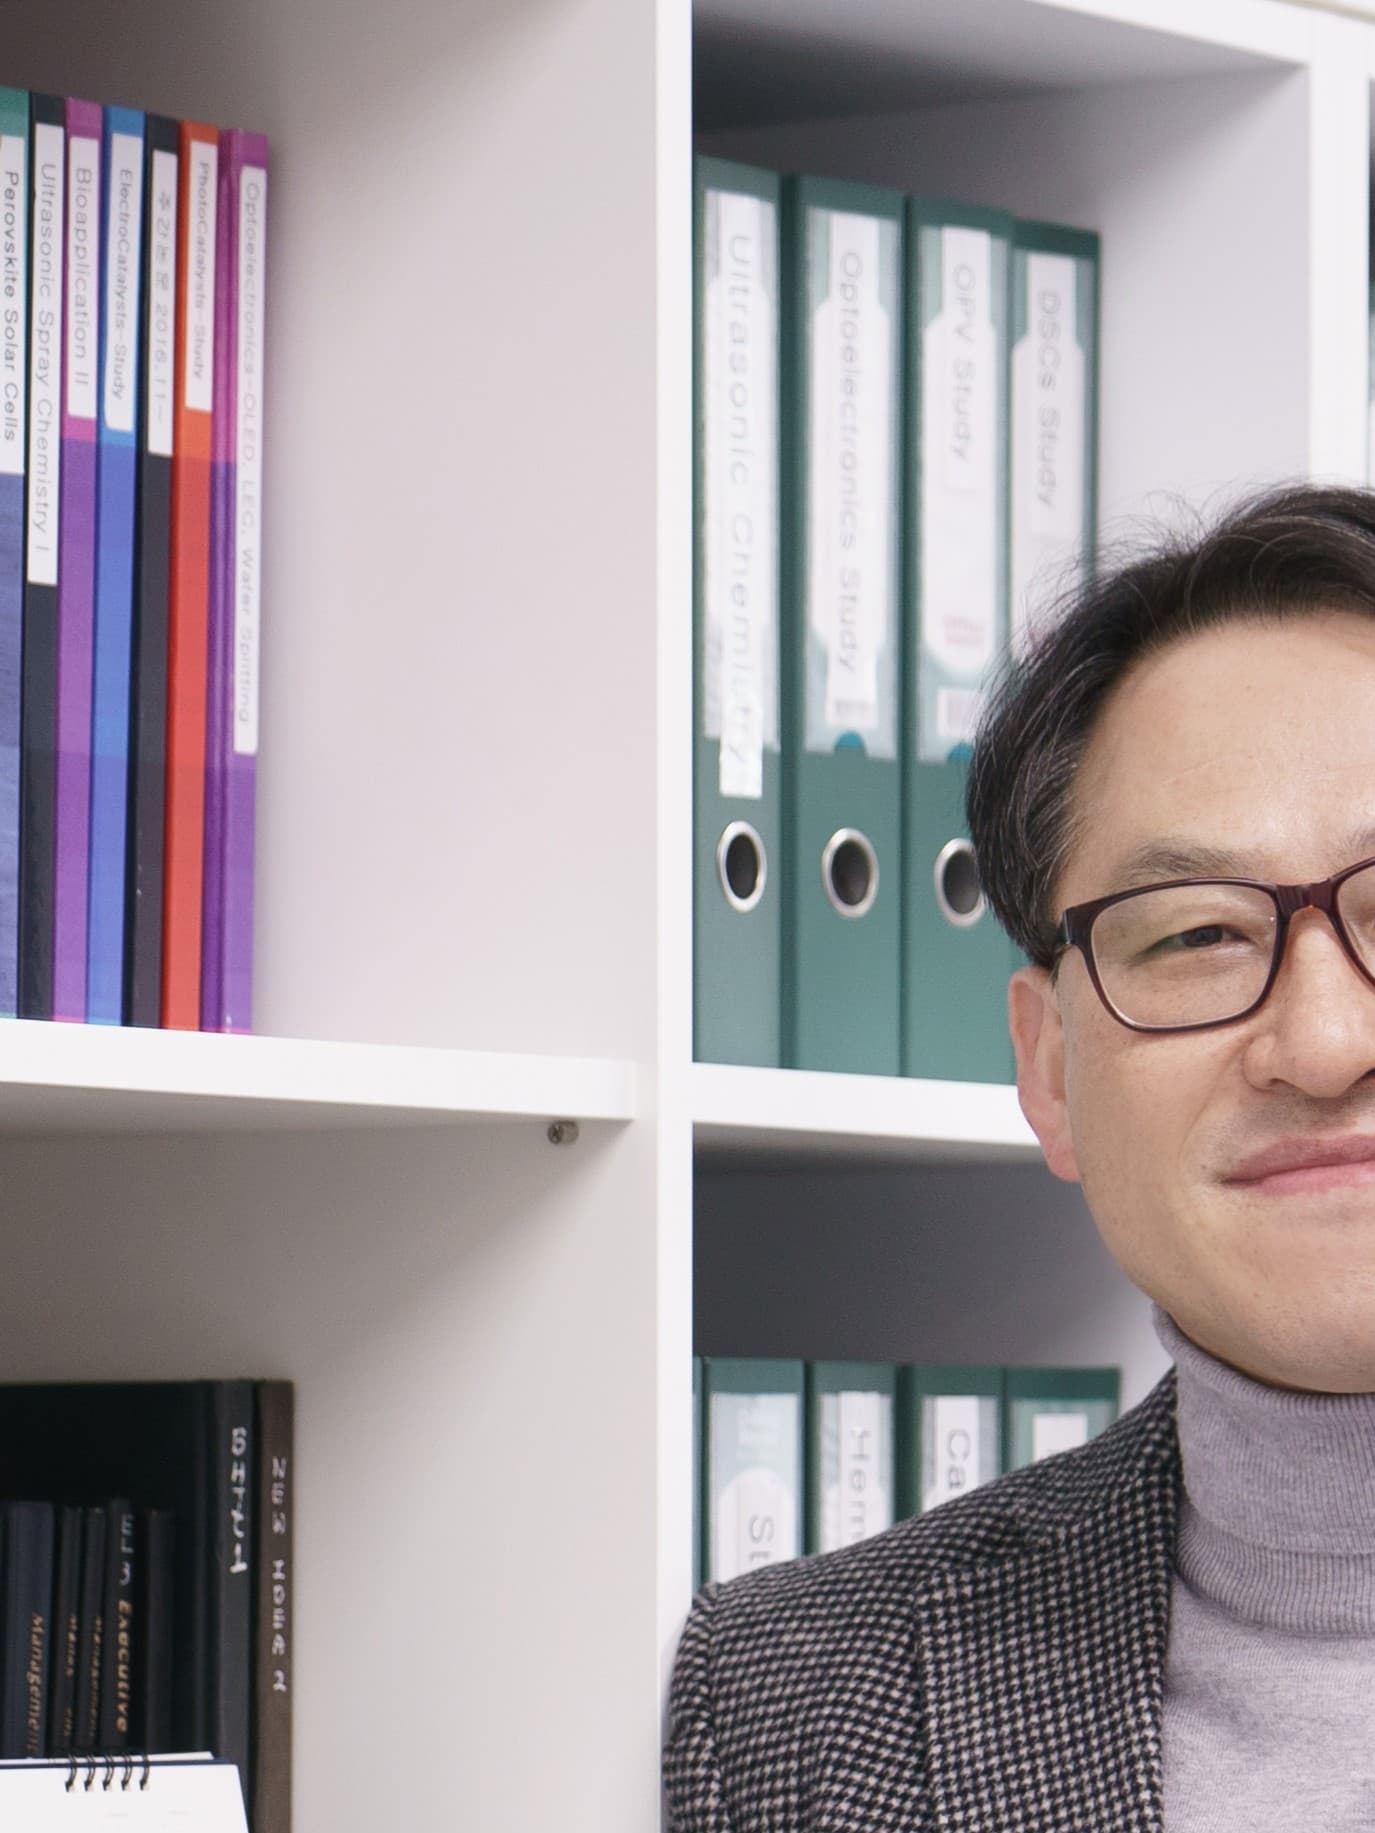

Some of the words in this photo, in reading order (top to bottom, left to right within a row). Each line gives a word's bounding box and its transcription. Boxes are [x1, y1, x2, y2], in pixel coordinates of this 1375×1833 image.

[3, 171, 20, 299] Perovskite
[39, 162, 57, 298] Ultrasonic
[73, 167, 92, 358] Bioapplication
[3, 307, 19, 372] Solar
[35, 308, 55, 386] Spray
[951, 262, 977, 346] OPV
[1037, 289, 1062, 391] DSCs
[1, 382, 18, 441] Cells
[726, 232, 756, 487] Ultrasonic
[835, 247, 864, 550] Optoelectronics
[951, 356, 977, 465] Study
[33, 398, 53, 535] Chemistry
[1035, 405, 1063, 511] Study
[834, 566, 863, 676] Study
[115, 1598, 134, 1735] Executive
